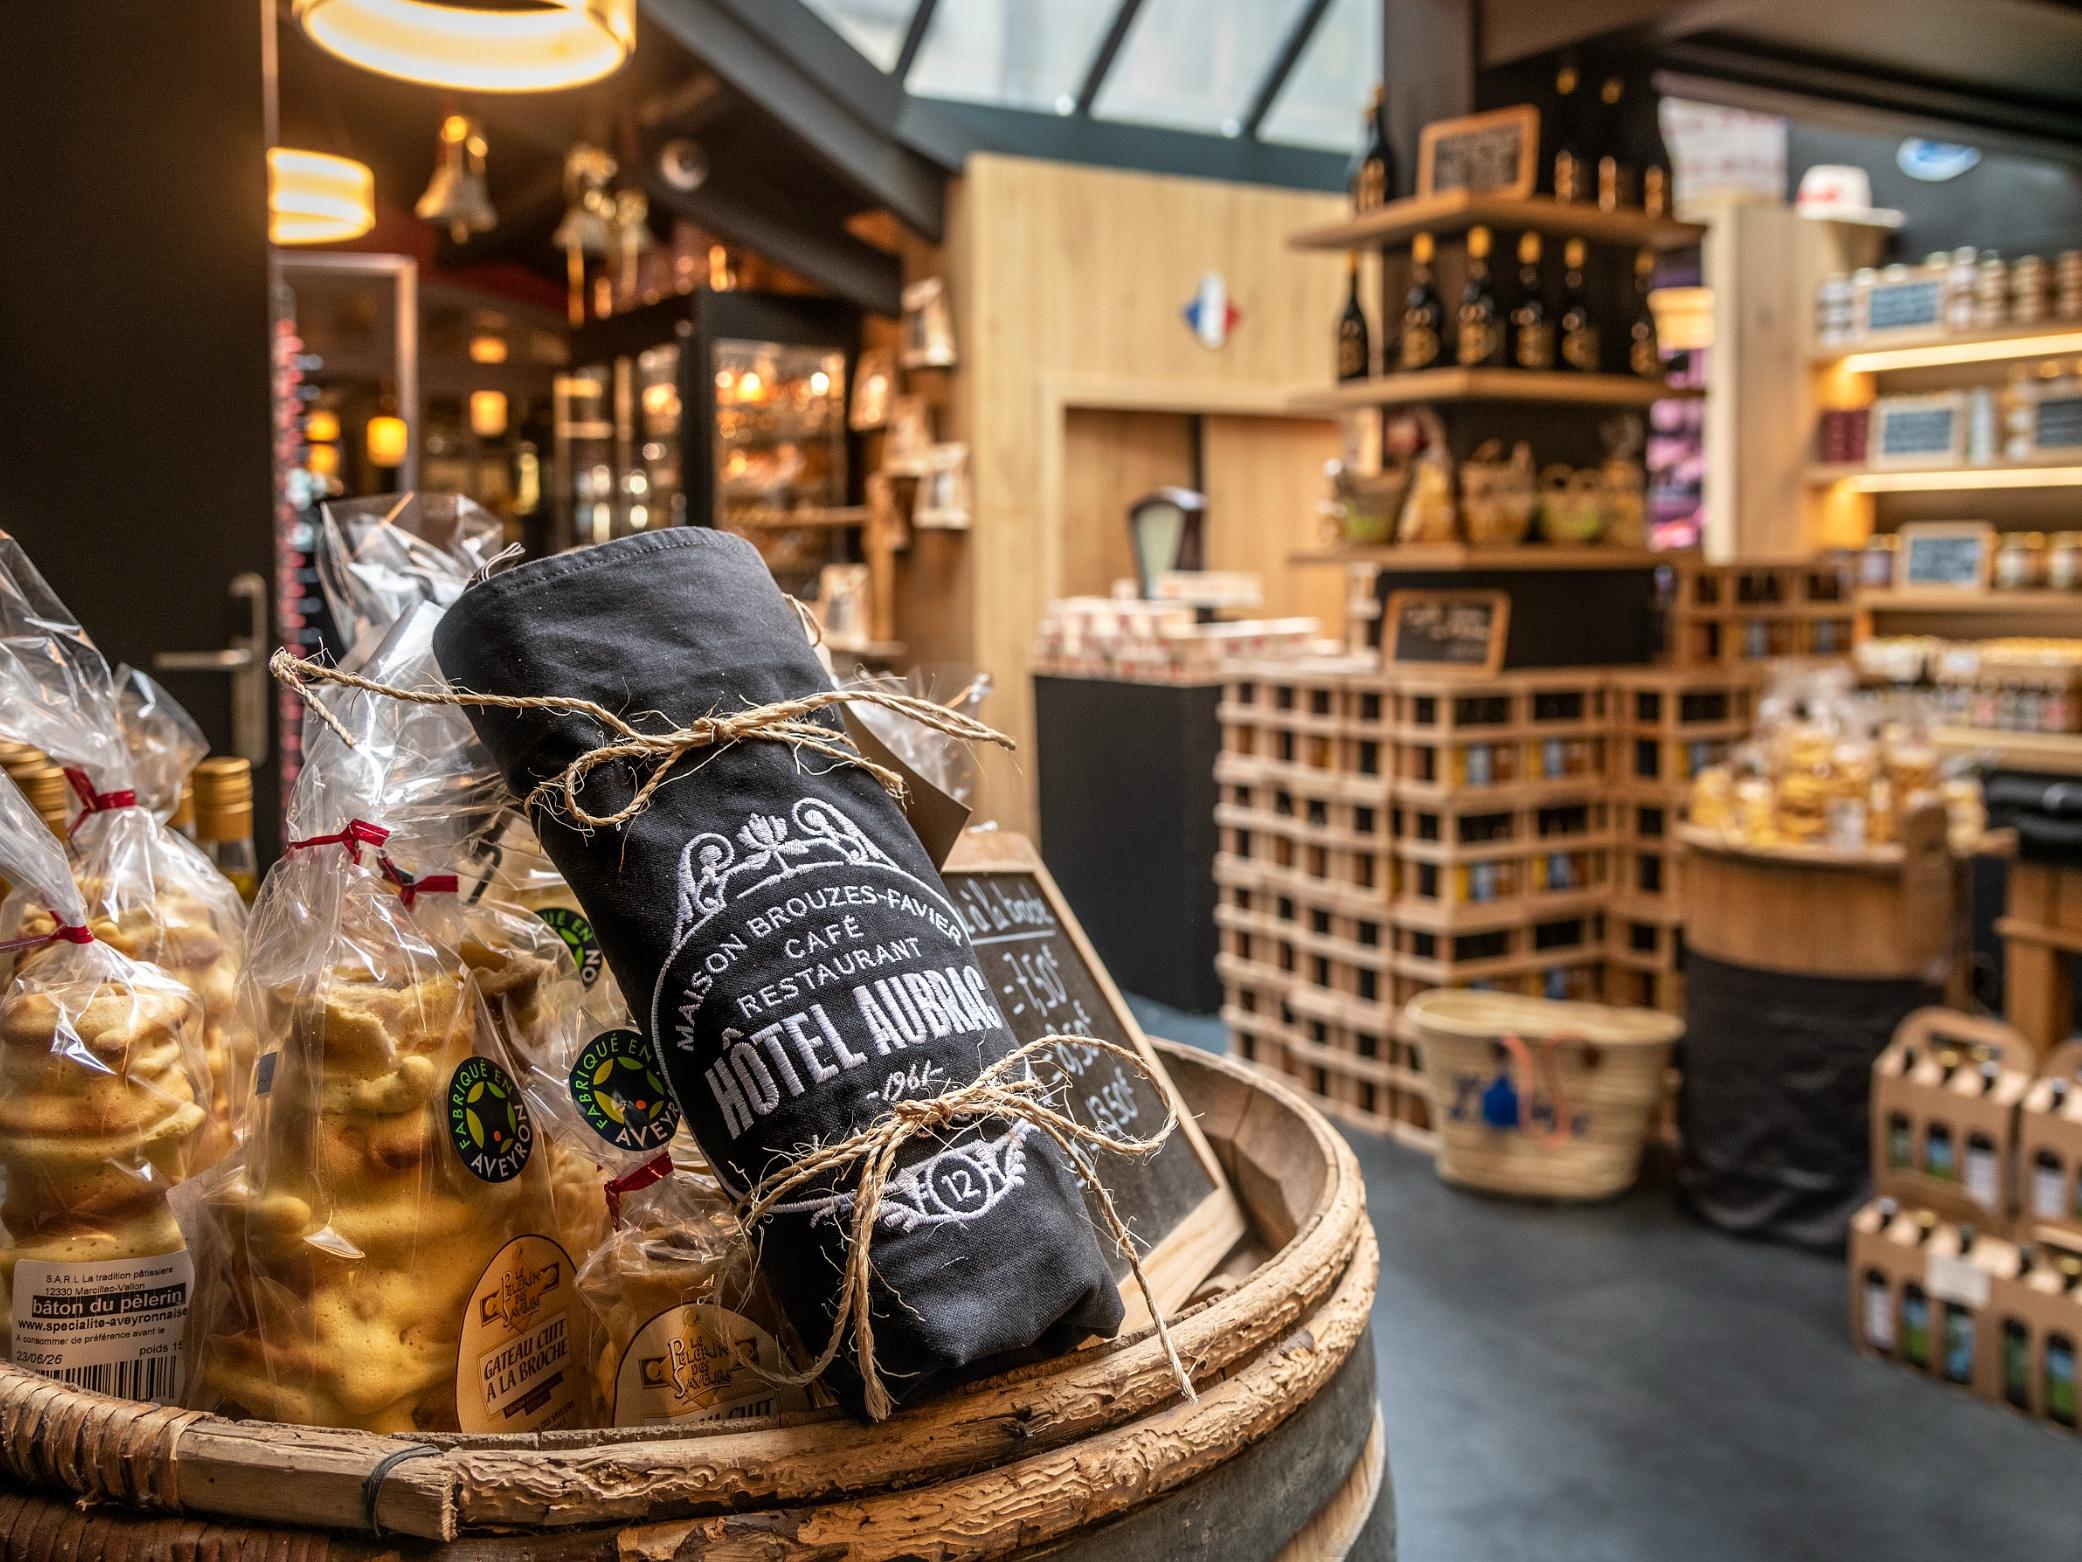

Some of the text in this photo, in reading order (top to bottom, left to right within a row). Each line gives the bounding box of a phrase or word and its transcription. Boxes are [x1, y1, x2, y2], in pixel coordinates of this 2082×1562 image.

[784, 917, 864, 959] CAFÉ
[676, 885, 962, 1051] MAISON BROUZES-FAVIER
[736, 937, 923, 1019] RESTAURANT
[704, 965, 1003, 1141] HÔTEL AUBRAC
[452, 1060, 513, 1150] FABRIQUÉ EN
[575, 1033, 652, 1130] FABRIQUÉ EN
[470, 1104, 532, 1178] AVEYRON
[614, 1100, 679, 1148] AVEYR
[941, 1169, 981, 1203] 12
[46, 1288, 73, 1296] 12330
[82, 1274, 94, 1283] La
[96, 1272, 131, 1281] tradition
[32, 1289, 182, 1316] bâton du pèlerin
[16, 1351, 63, 1365] 23/06/26
[23, 1336, 69, 1346] consommer
[71, 1336, 82, 1344] de
[84, 1332, 130, 1344] préférence
[132, 1329, 155, 1338] avant
[139, 1346, 169, 1356] poids
[485, 1318, 566, 1380] GATEAU CUIT
[486, 1386, 498, 1402] A
[500, 1374, 517, 1393] LA
[519, 1340, 568, 1382] BROCHE
